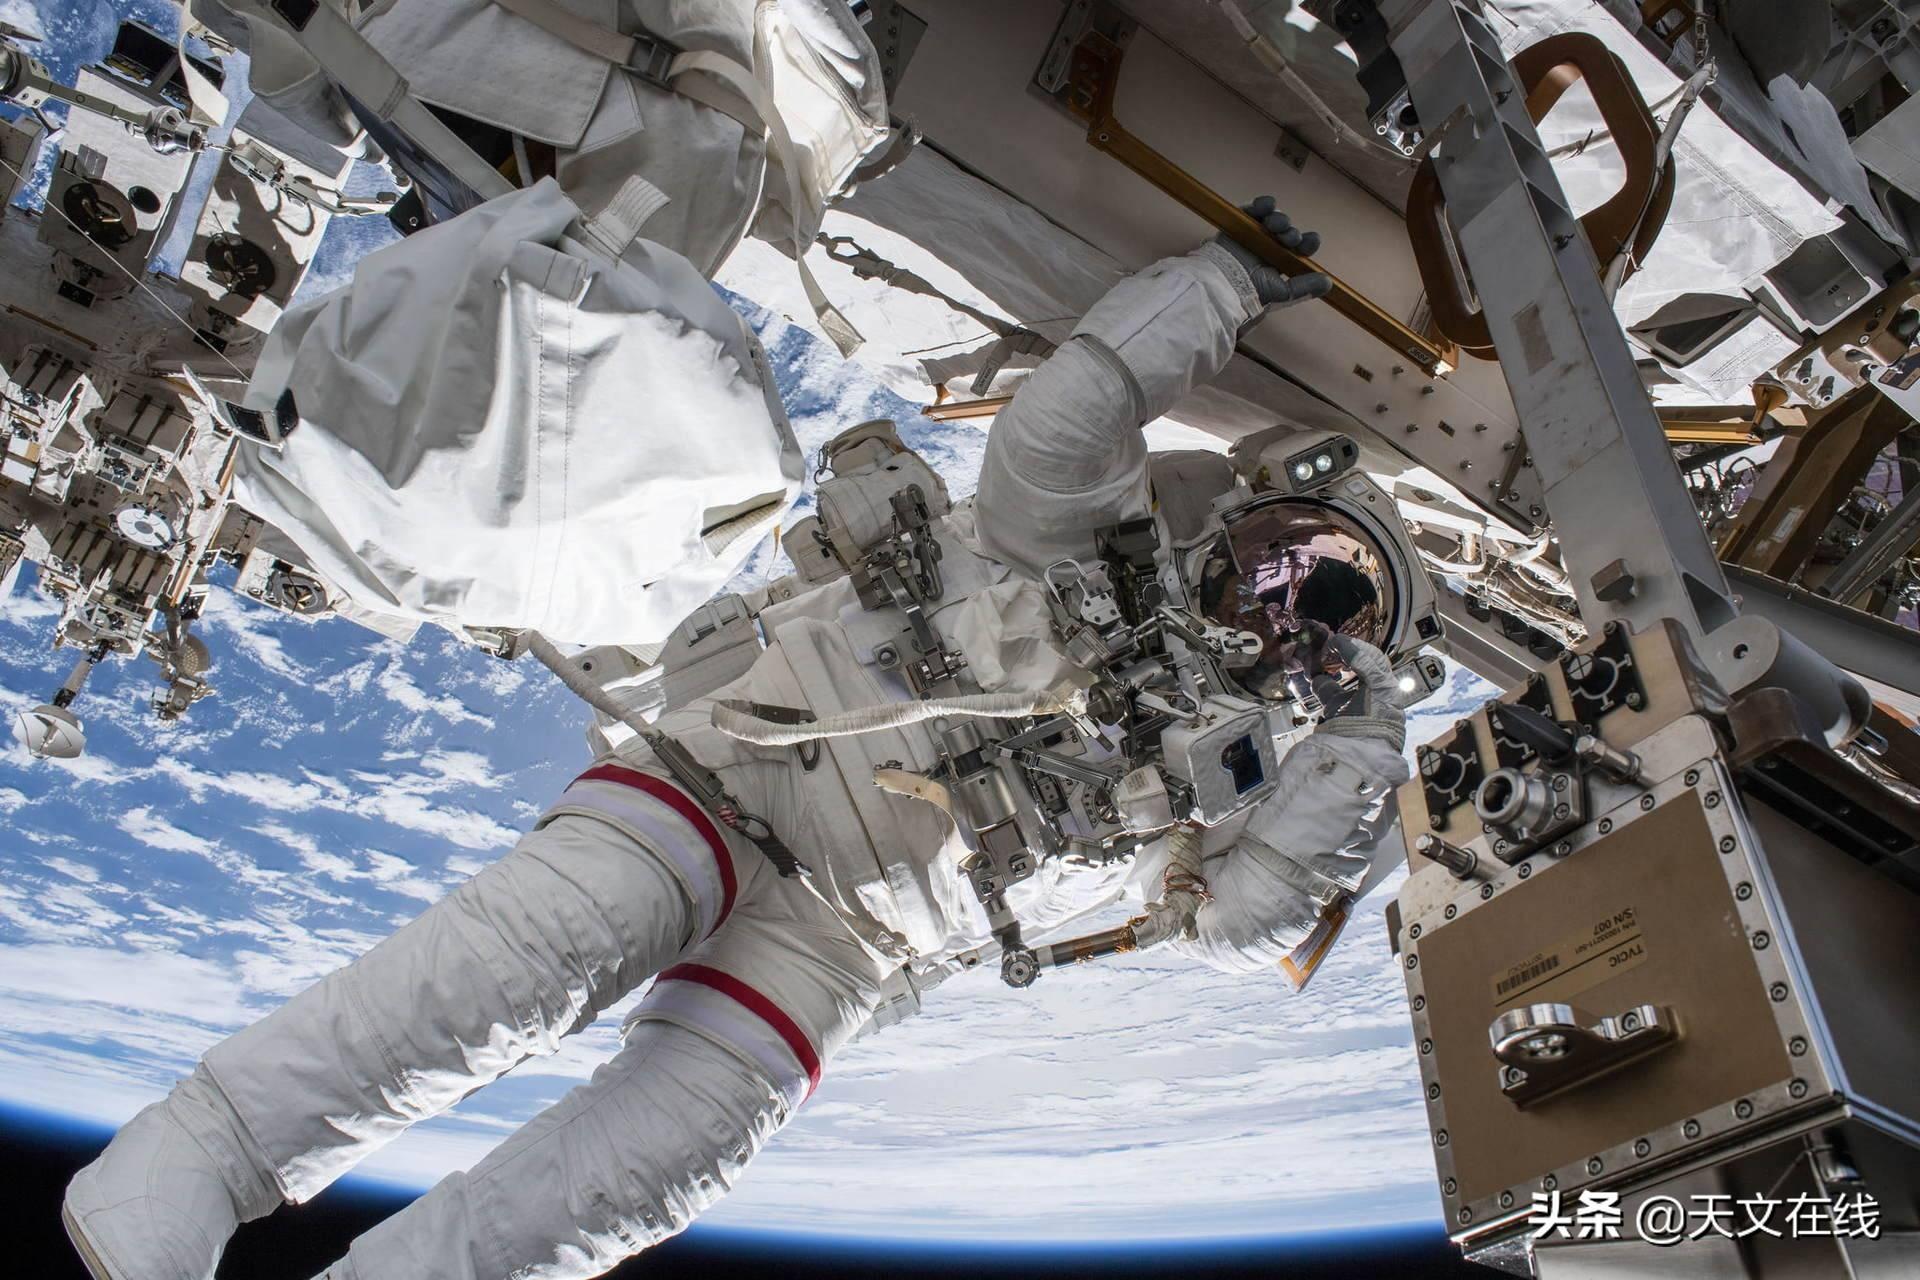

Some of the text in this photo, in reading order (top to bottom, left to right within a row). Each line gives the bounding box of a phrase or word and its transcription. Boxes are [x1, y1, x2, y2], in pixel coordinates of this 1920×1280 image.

[1593, 907, 1633, 936] S/N 007
[1608, 943, 1644, 967] TVCIC
